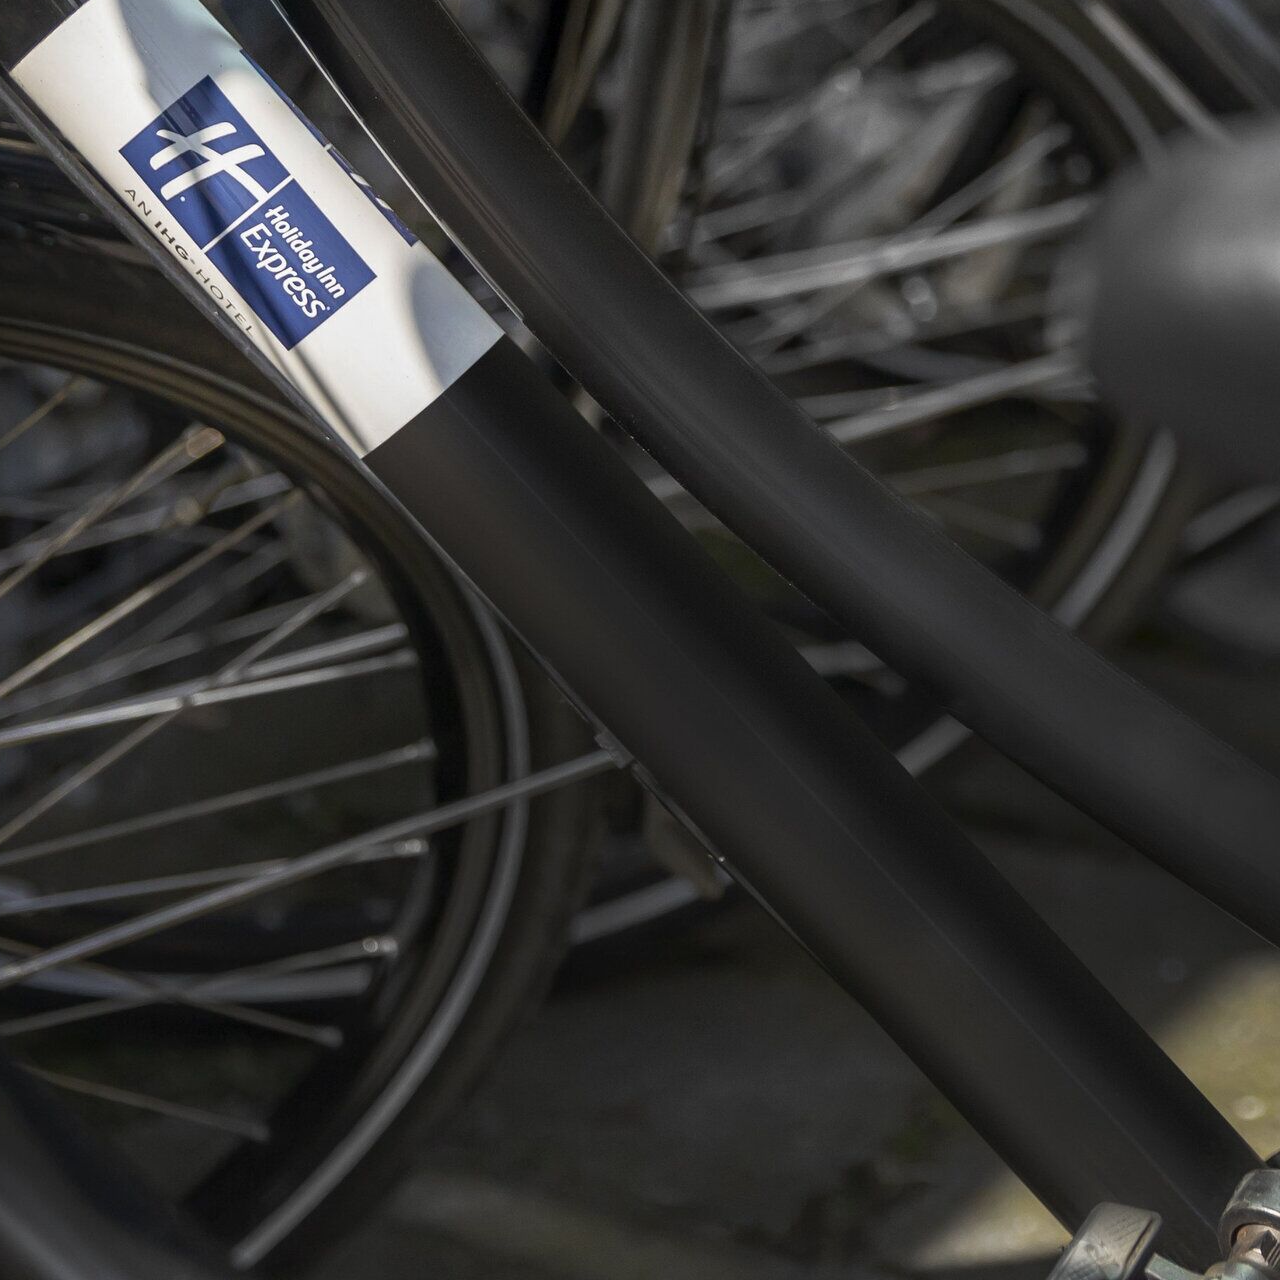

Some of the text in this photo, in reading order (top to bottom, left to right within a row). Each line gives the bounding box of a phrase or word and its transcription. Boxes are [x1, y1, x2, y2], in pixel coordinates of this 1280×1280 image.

[124, 188, 153, 217] AN
[195, 268, 257, 337] HOTEL
[240, 222, 327, 318] Express
[264, 204, 346, 299] Holiday Inn
